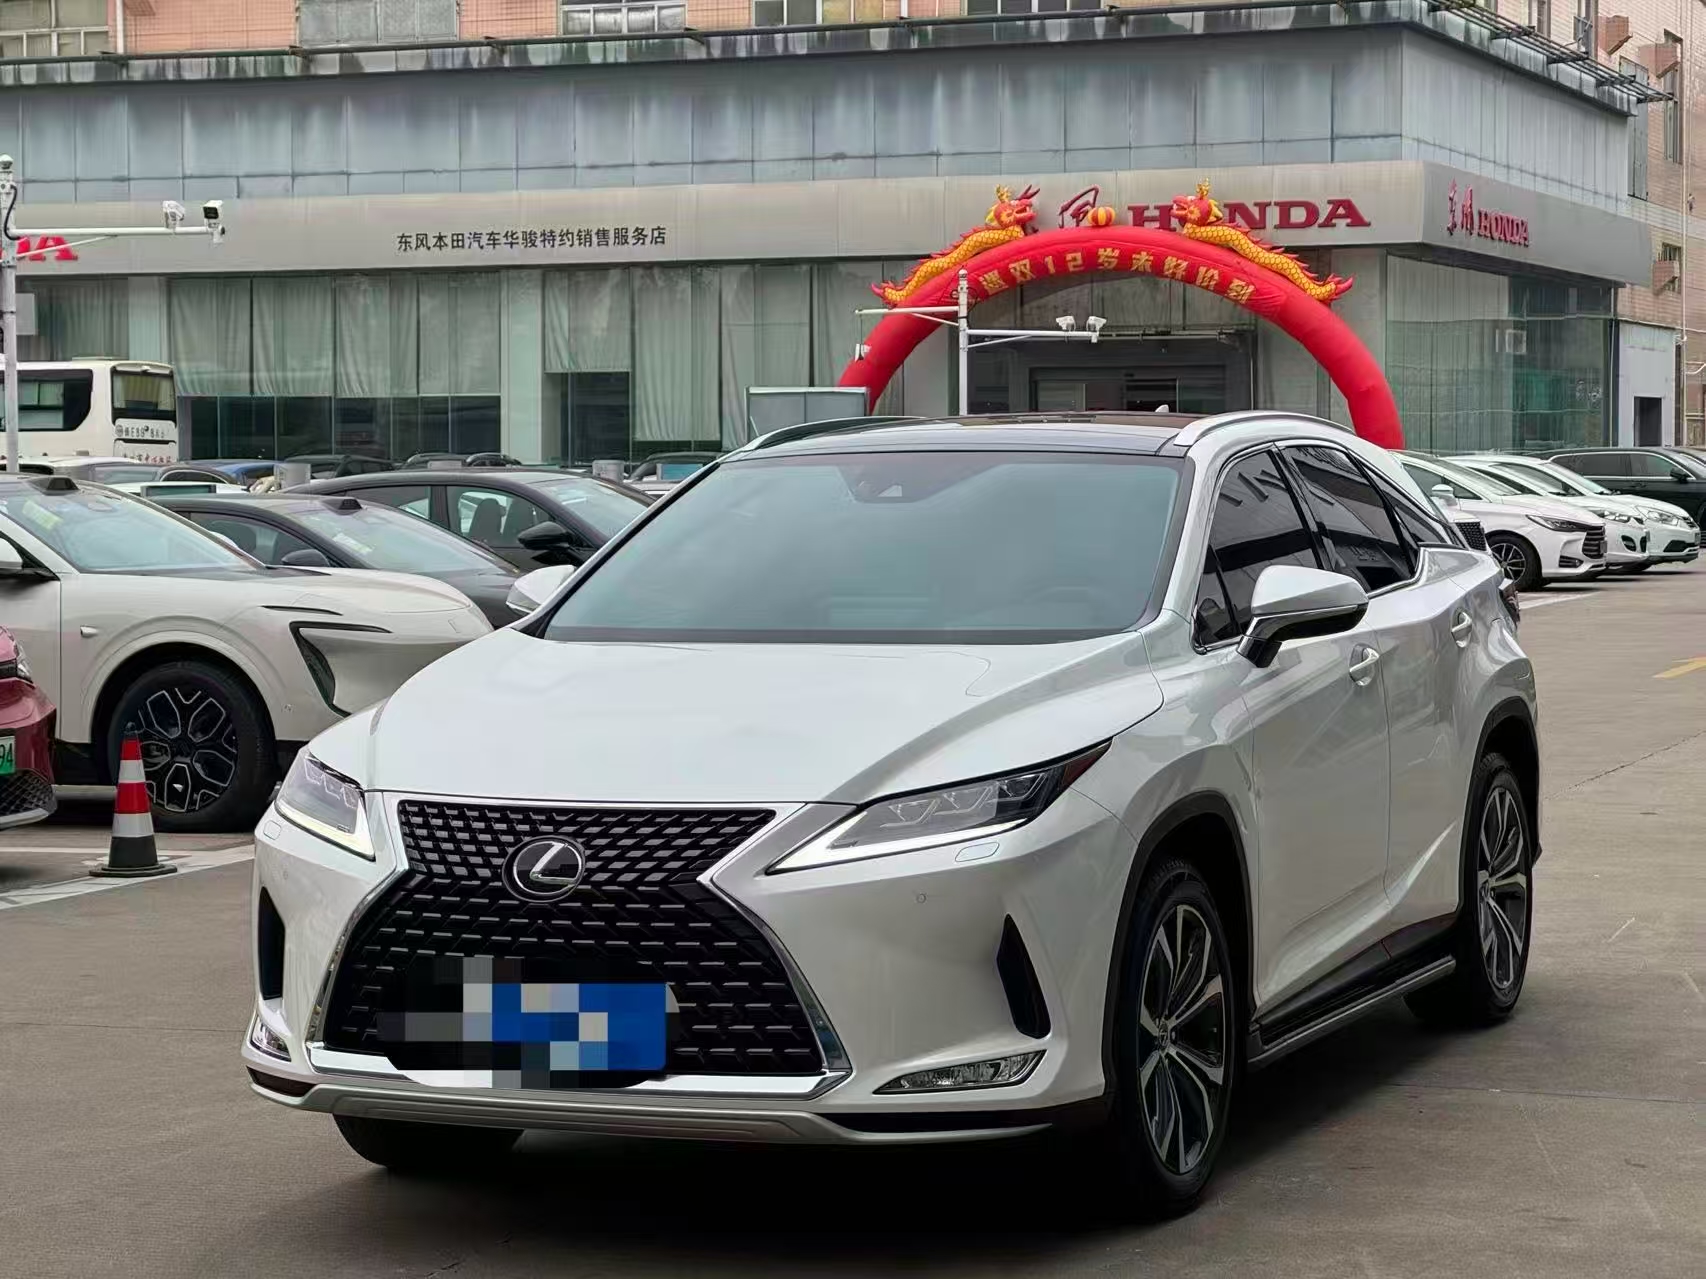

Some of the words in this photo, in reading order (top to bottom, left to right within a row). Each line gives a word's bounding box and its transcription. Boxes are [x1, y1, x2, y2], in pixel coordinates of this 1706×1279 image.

[1127, 198, 1371, 232] HNDA
[1478, 208, 1530, 248] HONDA
[396, 226, 667, 252] 东风本田汽车华骏特约销售服务店
